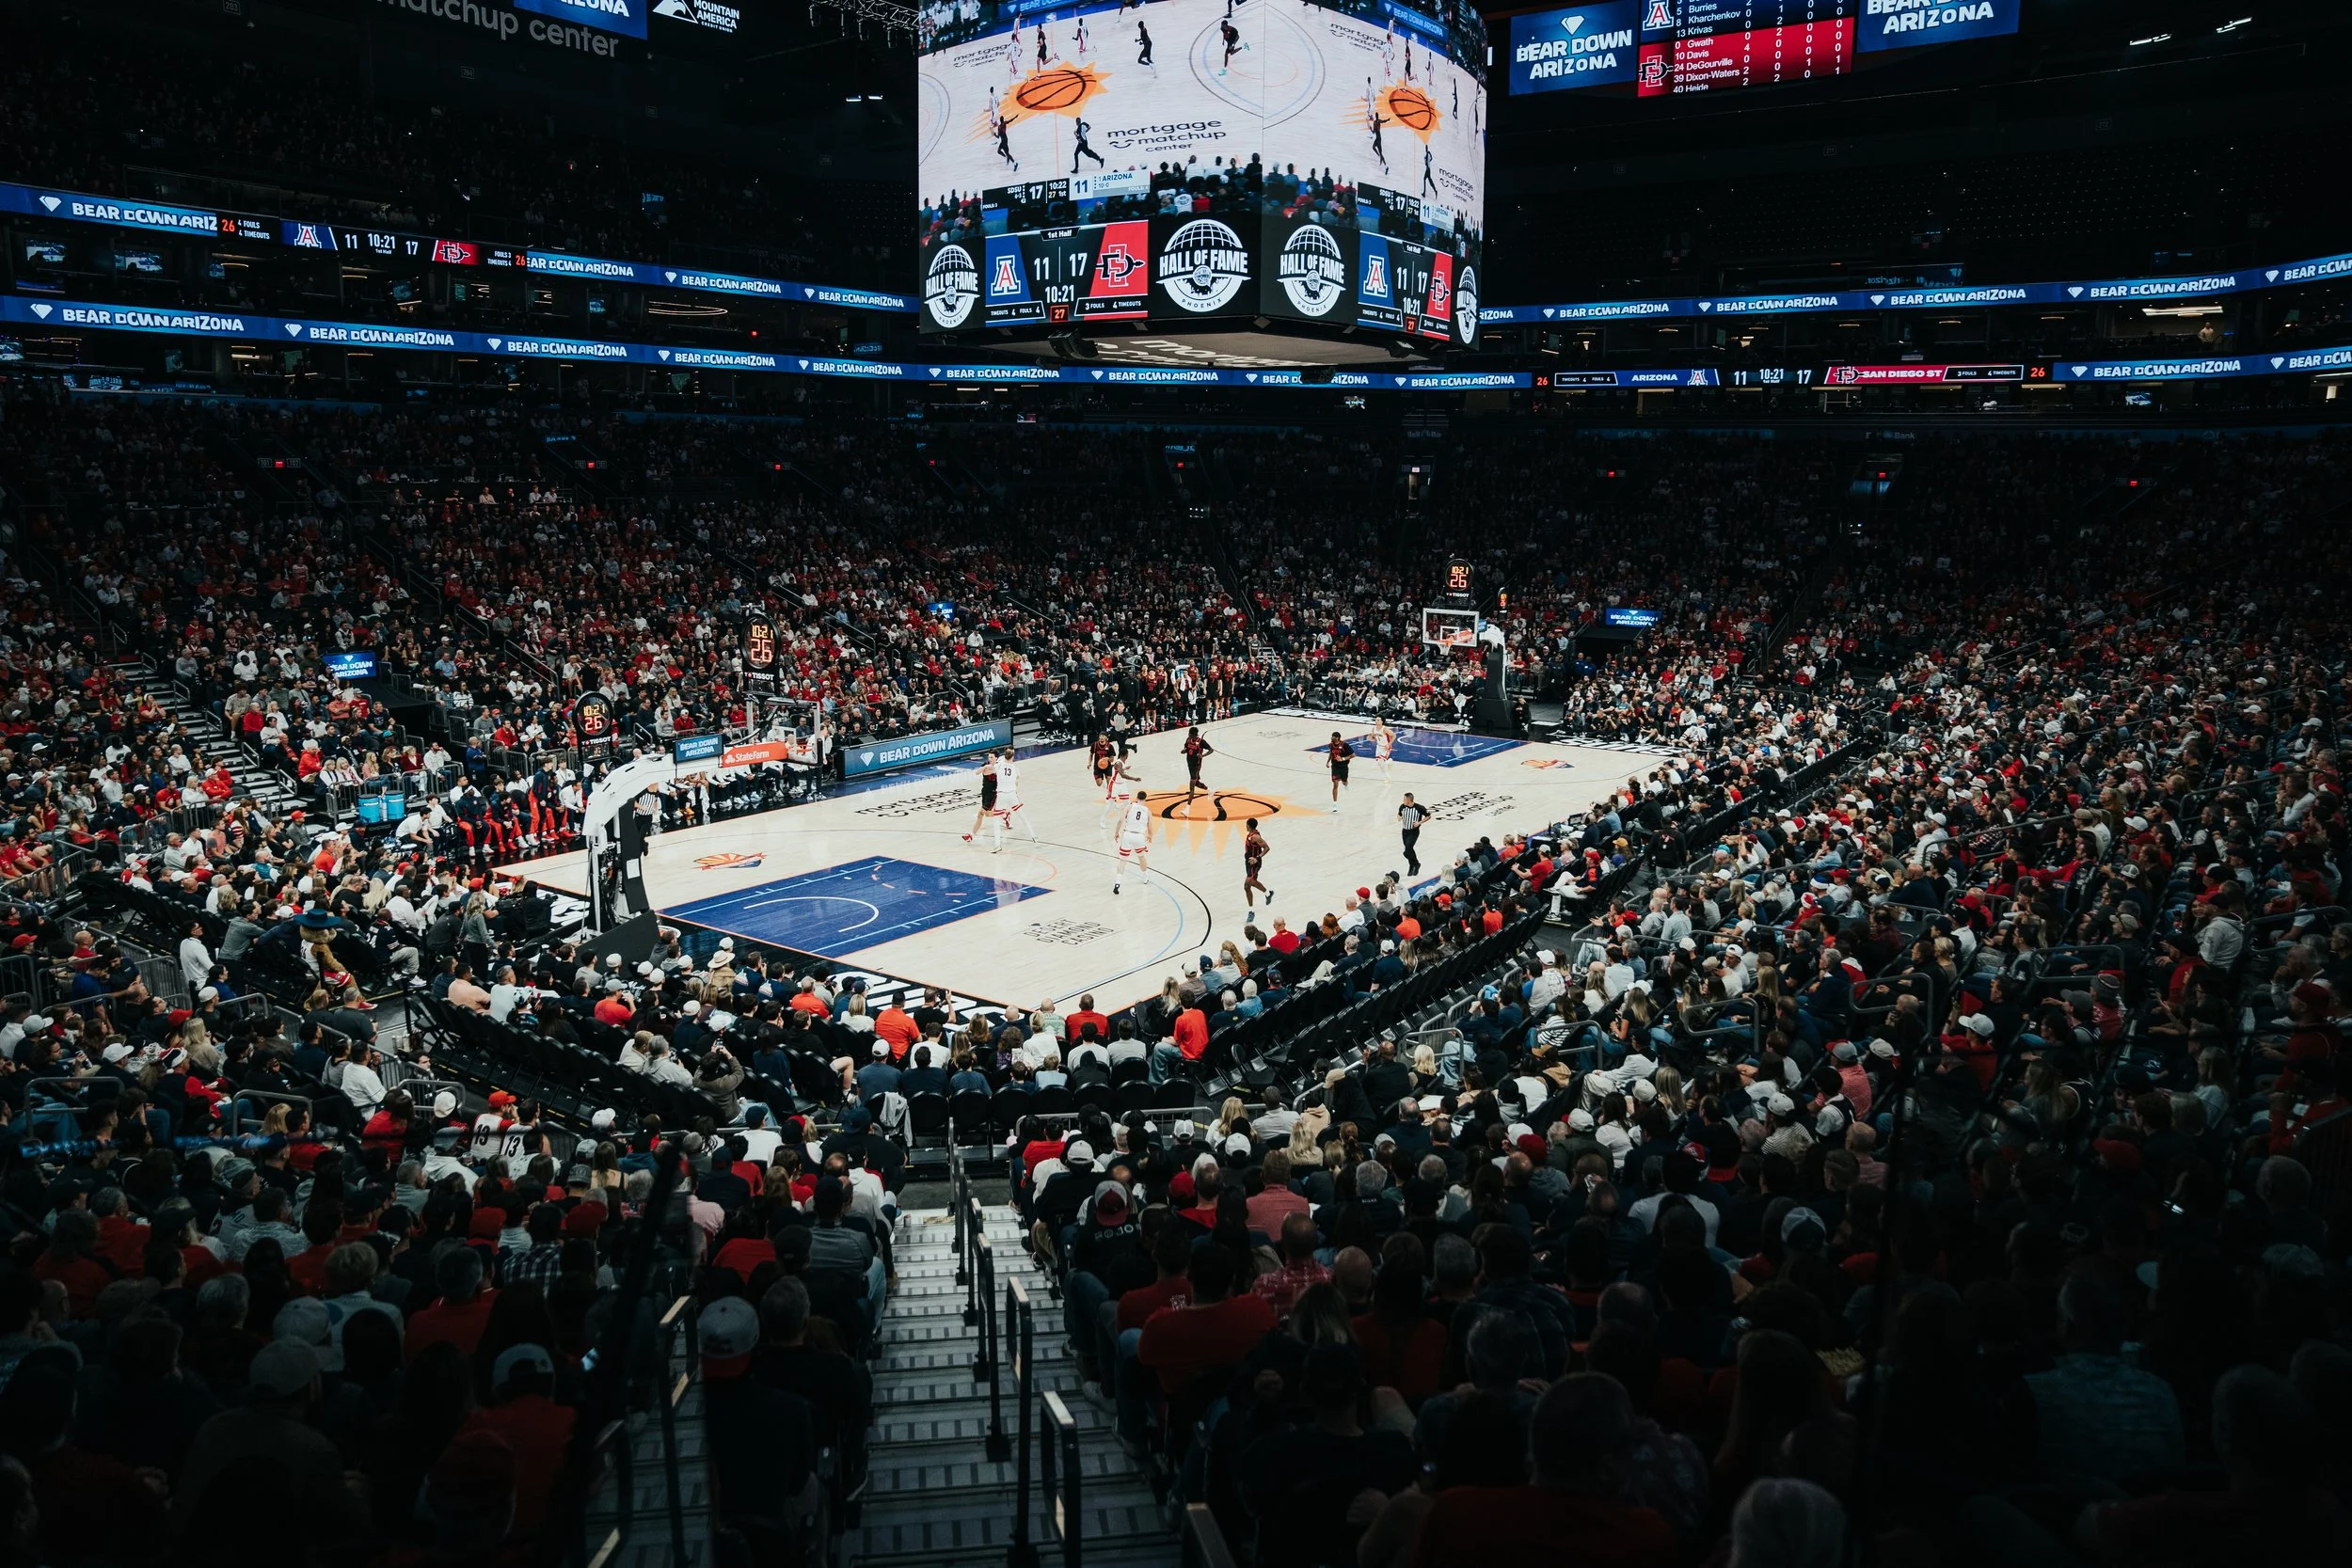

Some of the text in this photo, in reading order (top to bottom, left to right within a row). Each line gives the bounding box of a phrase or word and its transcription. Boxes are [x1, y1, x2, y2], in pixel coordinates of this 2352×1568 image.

[226, 1, 238, 12] 203
[694, 0, 739, 19] MOUNTAIN
[1689, 3, 1717, 13] Burries
[696, 10, 737, 29] AMERICA
[1689, 10, 1740, 24] Kharchenkov
[1883, 2, 1994, 34] ARIZONA
[381, 0, 518, 40] atchup
[529, 20, 619, 58] center
[718, 24, 733, 33] UNION
[1688, 25, 1713, 36] Krivas
[1517, 29, 1632, 62] BEAR DOWN
[1688, 38, 1713, 48] Gwath
[1676, 50, 1709, 60] 10 Davis
[1530, 53, 1616, 79] ARIZONA
[1675, 57, 1732, 71] 24 DeGourville
[1675, 69, 1740, 83] 39 Dixon-Waters
[1674, 85, 1683, 93] 40
[1107, 120, 1221, 137] mortgage
[1138, 132, 1226, 144] matchup
[1146, 143, 1192, 151] center
[1439, 167, 1474, 191] mortgage
[1029, 185, 1042, 199] 17
[1074, 180, 1088, 194] 11
[1396, 197, 1406, 211] 17
[1423, 205, 1430, 218] 11
[72, 202, 119, 220] BEAR
[179, 216, 217, 230] ARIZ
[222, 219, 234, 231] 26
[245, 230, 270, 239] TIMEOUTS
[1058, 230, 1073, 238] Half
[345, 234, 358, 248] 11
[368, 233, 395, 249] 10:21
[406, 241, 419, 255] 17
[516, 255, 525, 266] 26
[1034, 253, 1088, 280] 11 17
[1159, 249, 1248, 277] HALL OF FAME
[585, 263, 634, 277] ARIZONA
[1279, 254, 1344, 284] HALL OF FAME
[926, 271, 977, 297] HALL OF FAME
[1397, 267, 1427, 293] 11 17
[2090, 285, 2127, 297] BEAR
[2176, 277, 2235, 292] ARIZONA
[1045, 285, 1074, 303] 10:21
[1182, 298, 1221, 309] PHOENIX
[1297, 300, 1327, 312] PHOENIX
[1404, 297, 1420, 316] 10:21
[63, 309, 111, 324] BEAR
[170, 314, 244, 331] ARIZONA
[1055, 309, 1065, 319] 27
[1407, 321, 1414, 330] 27
[310, 327, 347, 341] BEAR
[394, 332, 454, 346] ARIZONA
[507, 341, 538, 353] BEAR
[578, 344, 628, 357] ARIZONA
[2031, 368, 2045, 377] 26
[2094, 366, 2131, 377] BEAR
[2181, 360, 2241, 373] ARIZONA
[1734, 372, 1747, 385] 11
[1759, 369, 1784, 380] 10:21
[1797, 370, 1811, 384] 17
[1450, 574, 1467, 588] 26
[752, 626, 773, 639] 10:21
[751, 639, 772, 662] 26
[753, 673, 774, 681] TISSOT
[584, 705, 606, 716] 10:21
[585, 716, 602, 731] 26
[680, 737, 718, 751] BEAR DOWN
[685, 746, 714, 756] ARIZONA
[880, 728, 995, 764] BEAR DOWN ARIZONA
[1004, 768, 1011, 777] 13
[854, 787, 971, 815] mortgage
[1136, 812, 1141, 820] 8
[1024, 919, 1076, 938] DESERT
[1037, 921, 1101, 943] DIAMOND
[1061, 927, 1114, 945] CASINO
[474, 1124, 490, 1146] 13
[504, 1136, 520, 1157] 13
